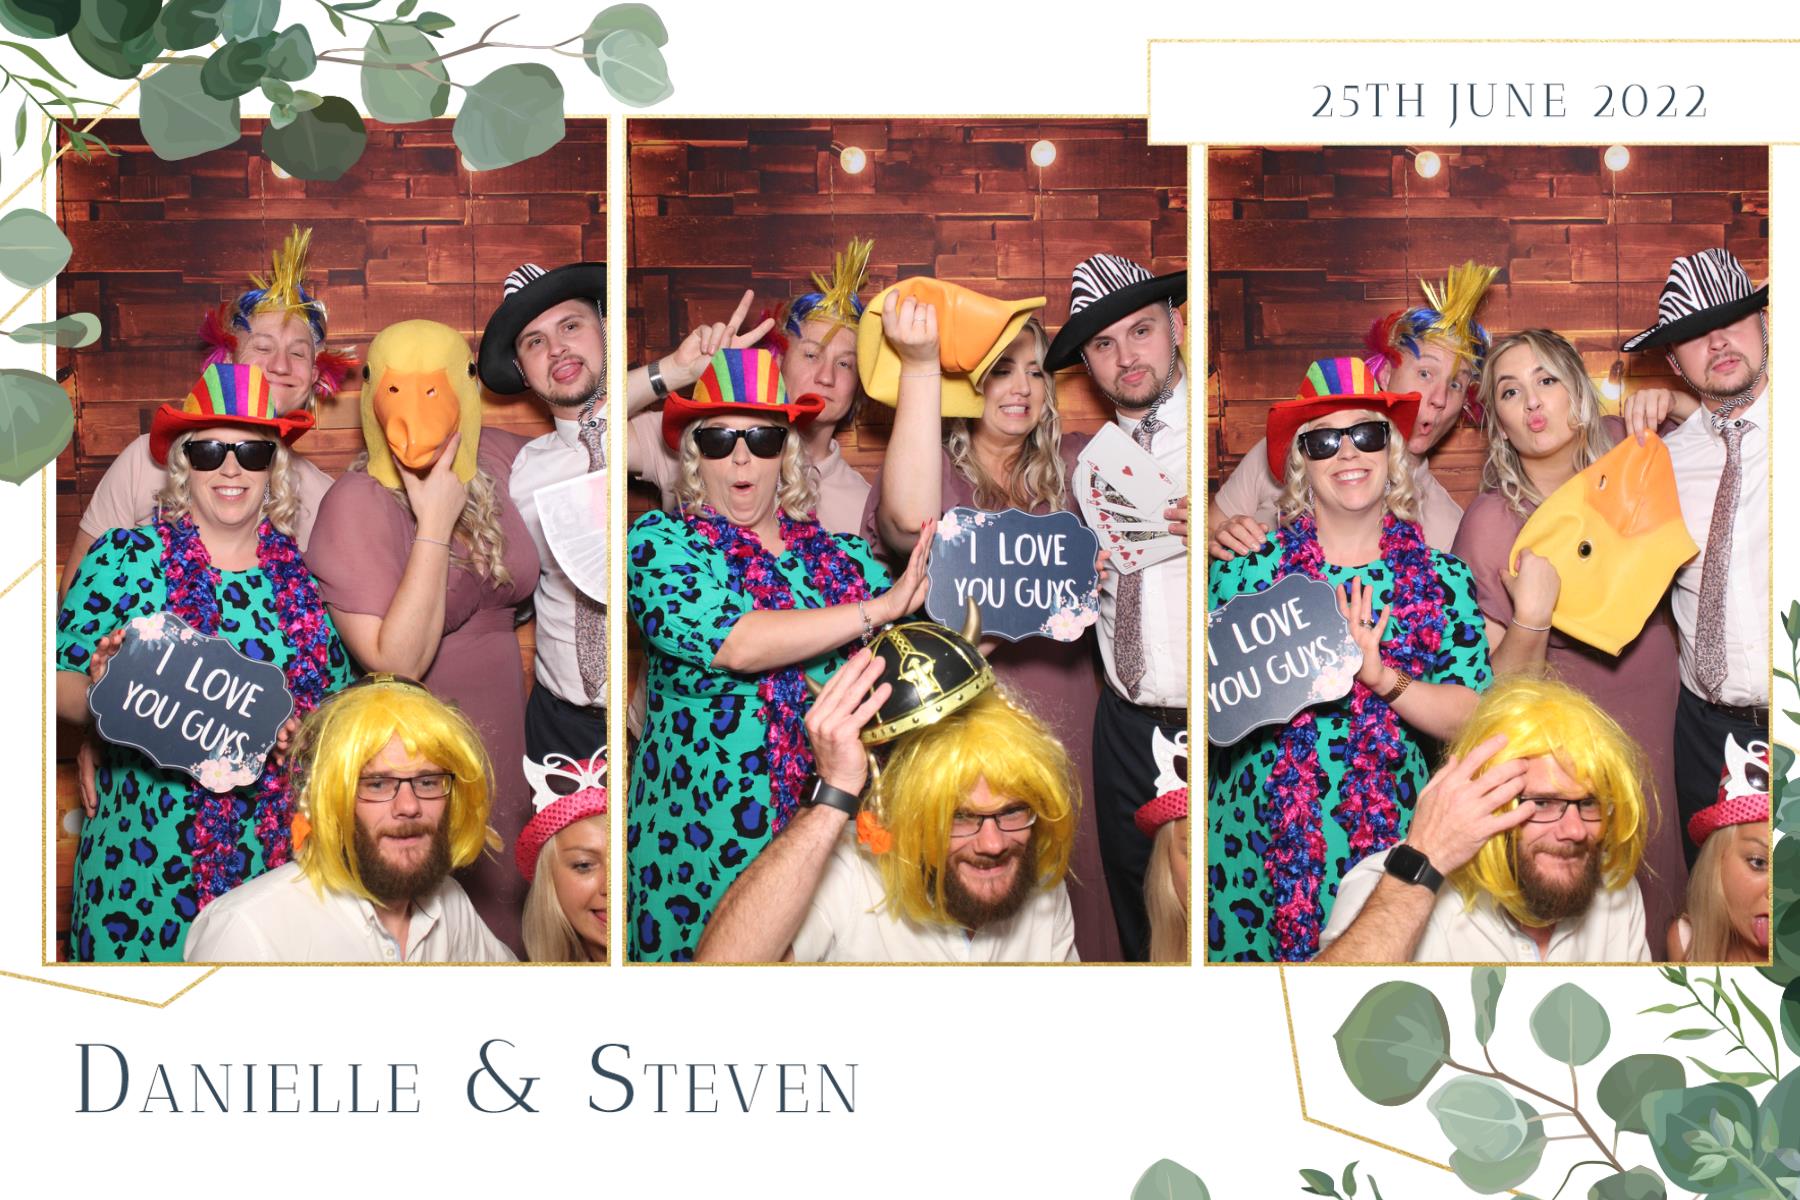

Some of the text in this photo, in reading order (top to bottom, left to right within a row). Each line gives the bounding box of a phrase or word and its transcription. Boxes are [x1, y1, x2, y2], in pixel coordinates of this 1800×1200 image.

[970, 530, 1068, 567] I LOVE
[954, 577, 1079, 610] YOU GUYS
[1231, 597, 1311, 654] LOVE
[156, 642, 265, 718] I LOVE
[1208, 635, 1338, 713] YOU GUYS
[122, 680, 250, 764] YOU GUYS
